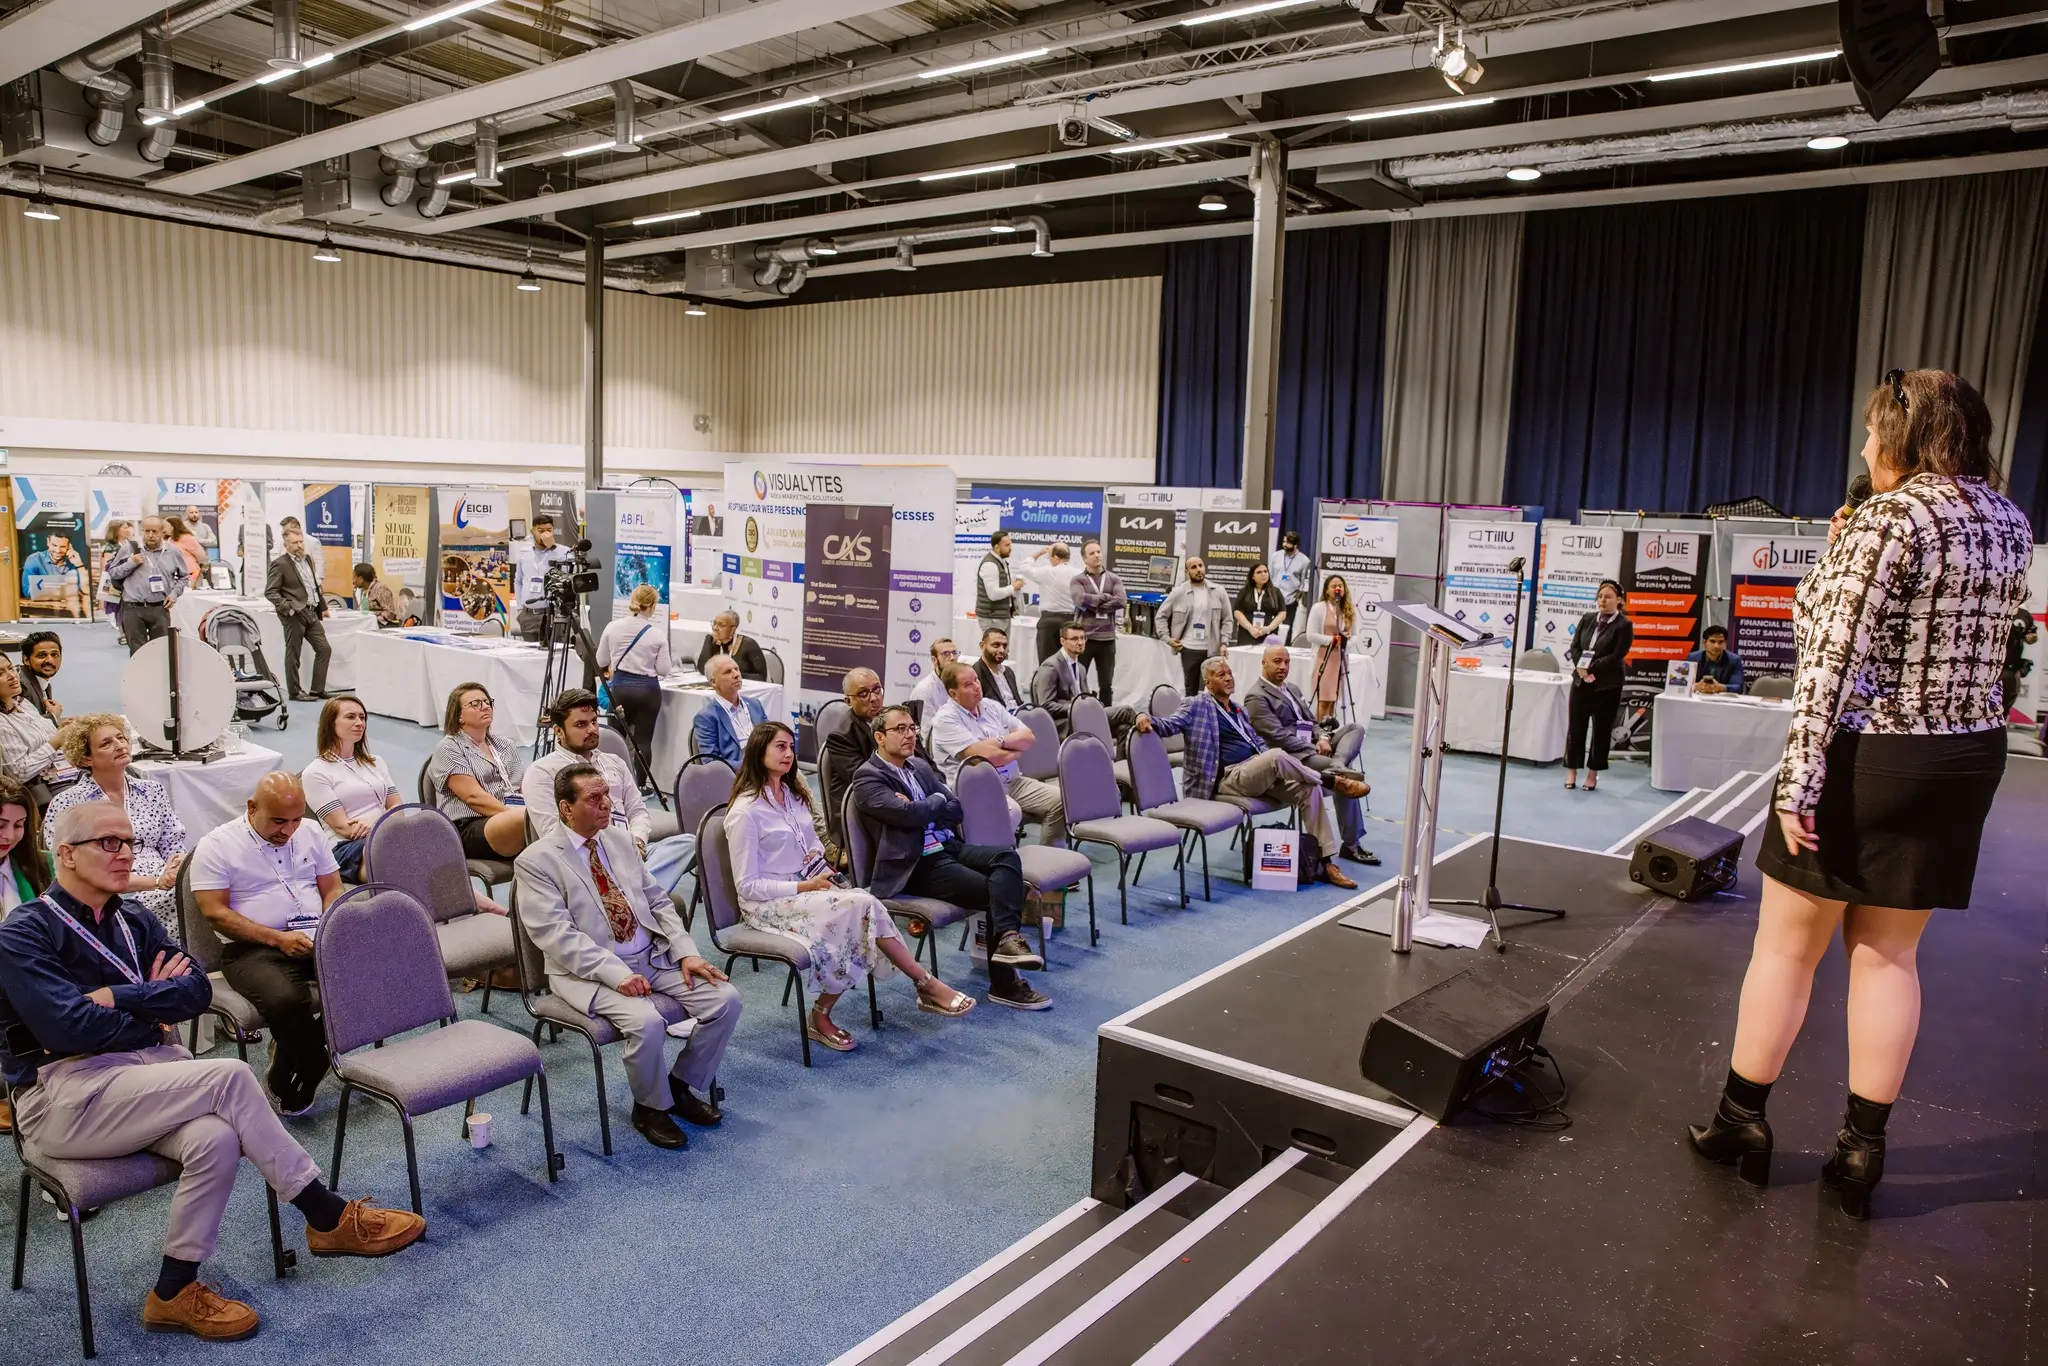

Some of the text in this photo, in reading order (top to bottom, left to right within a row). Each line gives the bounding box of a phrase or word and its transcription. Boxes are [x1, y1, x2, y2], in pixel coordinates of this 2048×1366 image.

[174, 482, 206, 494] BBX
[768, 473, 843, 493] VISUALYTES
[1150, 492, 1173, 502] TillU
[466, 504, 492, 513] EICBI
[1022, 498, 1038, 508] Sign
[1056, 500, 1094, 509] document
[748, 504, 761, 512] YOUR
[762, 504, 774, 514] WEB
[1021, 510, 1092, 524] Online now!
[384, 522, 415, 534] SHARE,
[1120, 516, 1163, 530] KIA
[1214, 520, 1258, 534] KIA
[1008, 532, 1083, 544] SIGNITONLINE.CO.UK
[1485, 530, 1514, 542] TillU
[1116, 538, 1136, 546] MILTON
[1332, 536, 1376, 548] GLOBAL
[1576, 536, 1602, 548] TillU
[823, 533, 872, 562] CAS
[1143, 547, 1166, 555] CENTRE
[1229, 544, 1250, 552] KEYNES
[1208, 550, 1260, 560] BUSINESS CENTRE
[1326, 562, 1346, 570] QUICK,
[1367, 564, 1386, 572] SIMPLE
[1636, 574, 1670, 582] Empowering
[1636, 581, 1666, 589] Enriching
[1469, 590, 1502, 598] POSSIBILITIES
[1740, 619, 1780, 628] FINANCIAL
[1738, 639, 1774, 648] REDUCED
[1738, 649, 1769, 657] BURDEN
